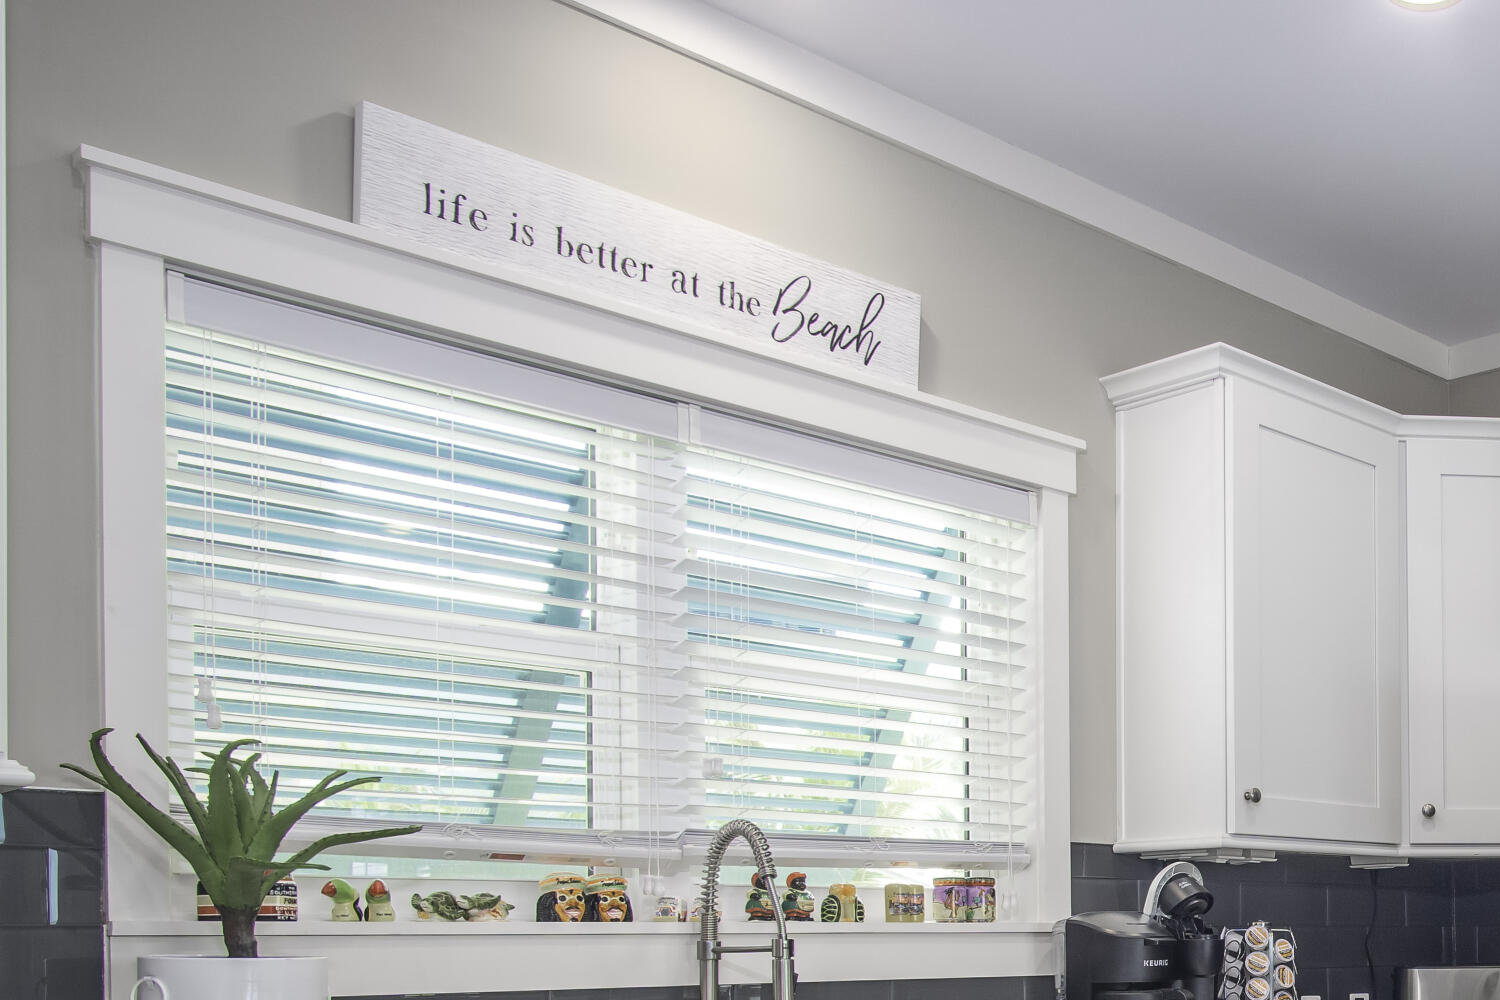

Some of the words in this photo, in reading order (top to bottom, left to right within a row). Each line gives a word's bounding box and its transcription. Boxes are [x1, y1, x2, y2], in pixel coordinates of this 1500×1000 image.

[421, 182, 488, 233] life
[509, 211, 535, 247] is
[555, 226, 655, 284] better
[671, 268, 701, 299] at
[717, 280, 761, 318] the
[772, 275, 885, 367] Beach
